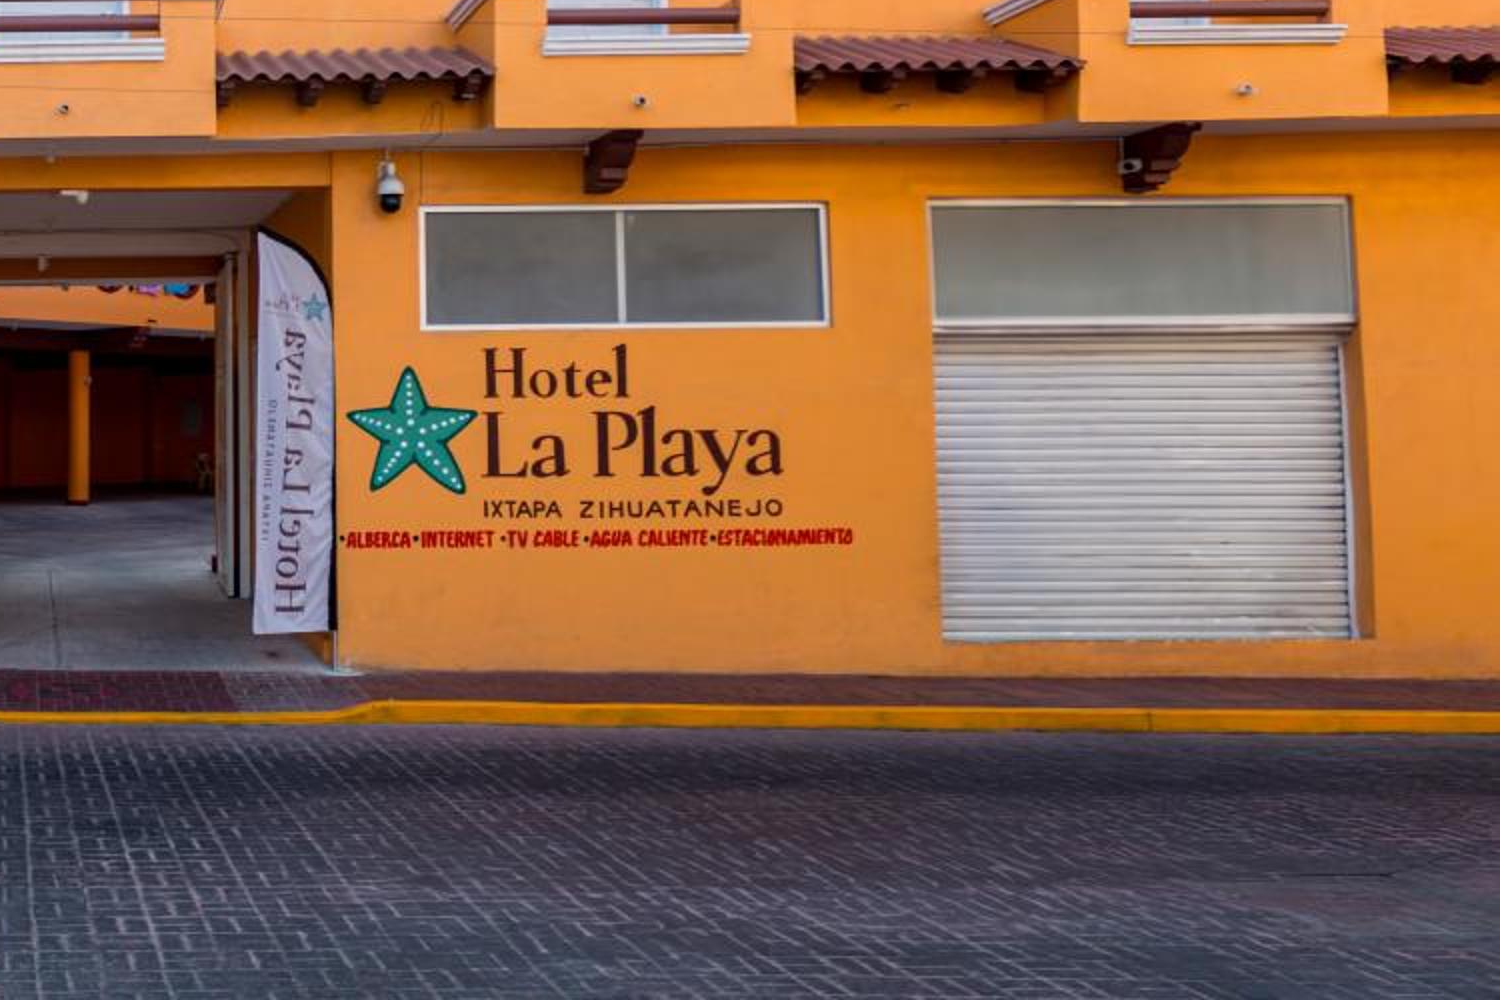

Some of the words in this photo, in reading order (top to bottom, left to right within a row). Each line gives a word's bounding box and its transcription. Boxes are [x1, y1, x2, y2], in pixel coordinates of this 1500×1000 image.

[483, 343, 630, 399] Hotel
[481, 411, 571, 479] La
[592, 405, 784, 496] Playa
[483, 501, 563, 519] IXTAPA
[579, 499, 784, 519] ZIHUATANEJO
[346, 530, 412, 549] ALBERCA
[421, 530, 495, 549] INTERNET
[507, 529, 529, 548] TV
[533, 530, 579, 548] CABLE
[590, 529, 633, 548] AGUA
[638, 529, 709, 547] CALIENTE
[717, 528, 854, 547] ESTACIONAMIENTO
